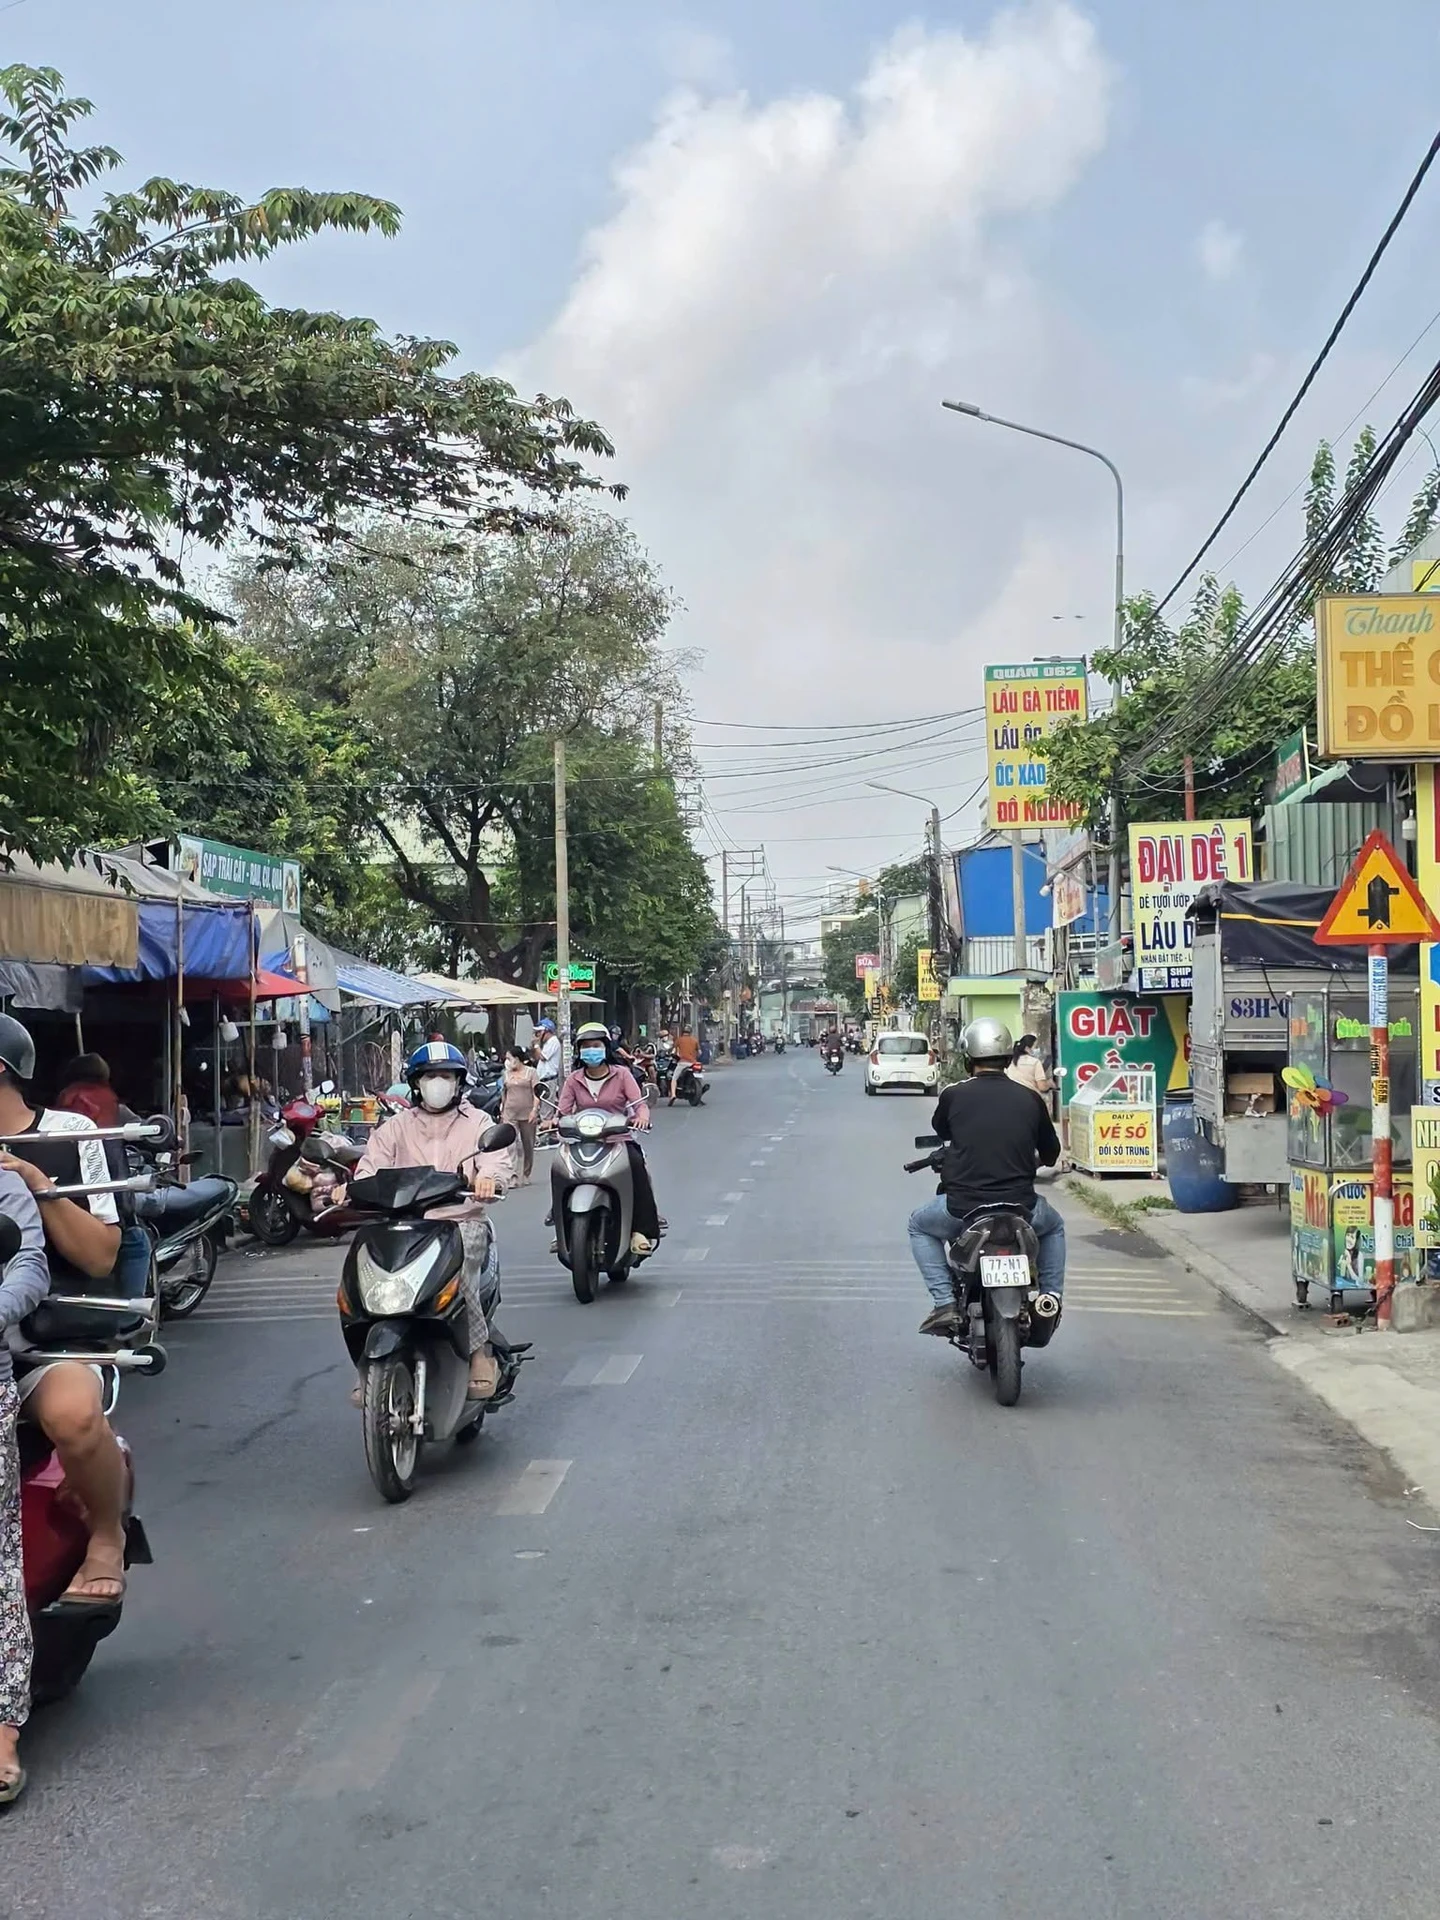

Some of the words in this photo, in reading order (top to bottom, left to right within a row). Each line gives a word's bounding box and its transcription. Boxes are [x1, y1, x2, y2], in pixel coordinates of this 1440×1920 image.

[1345, 604, 1434, 636] Thanh
[1043, 666, 1077, 677] 062
[1339, 636, 1415, 688] THẾ
[993, 683, 1018, 714] LẨU
[1023, 685, 1042, 713] GÀ
[1045, 683, 1079, 712] TIỀM
[1344, 689, 1414, 742] ĐỒ
[994, 719, 1019, 751] LẨU
[995, 758, 1014, 787] ỐC
[997, 794, 1019, 823] ĐỒ
[1138, 836, 1186, 893] ĐẠI
[1191, 824, 1228, 883] DÊ
[1234, 833, 1248, 879] 1
[1141, 910, 1176, 951] LẨU
[547, 962, 593, 981] Cffee
[1170, 967, 1192, 976] SHIP
[1071, 998, 1157, 1047] GIẶT
[1099, 1123, 1122, 1139] VÉ
[1125, 1121, 1148, 1139] SỐ
